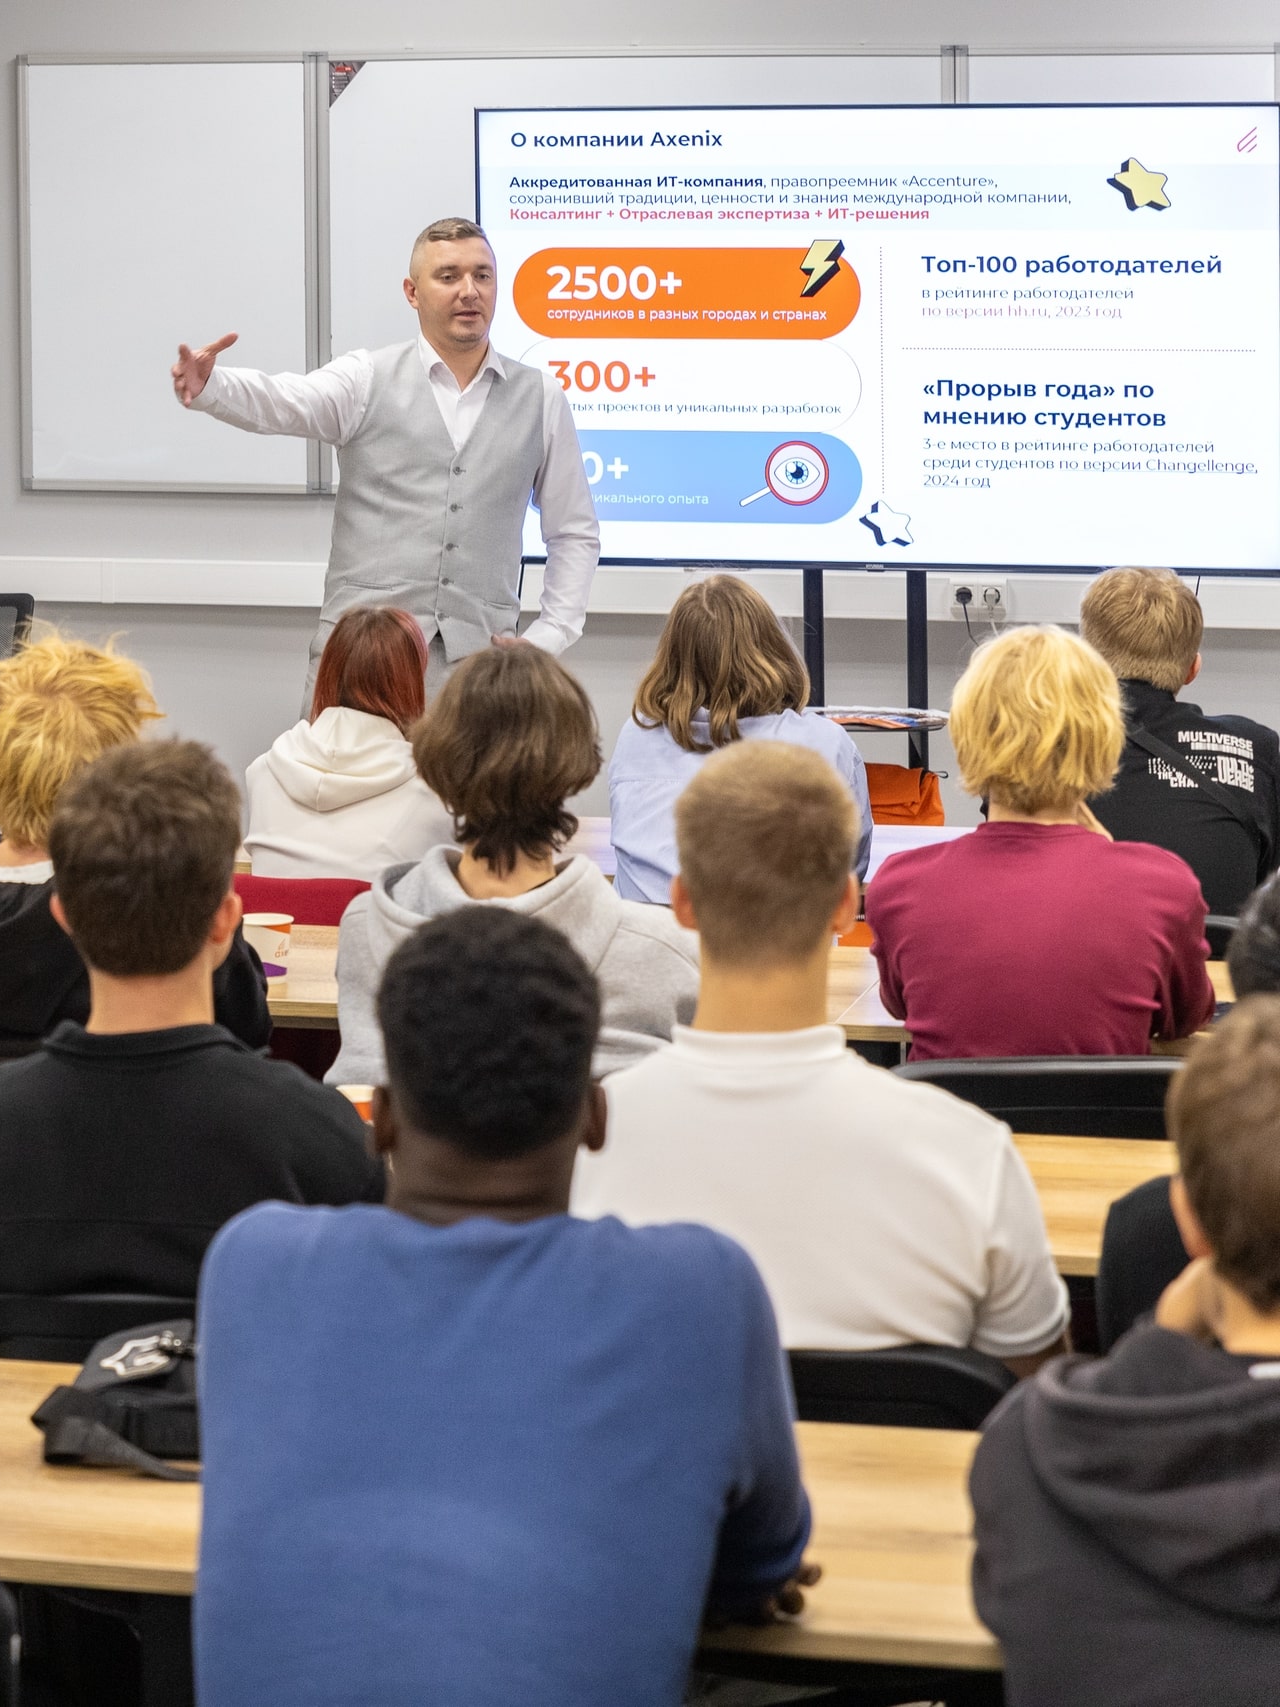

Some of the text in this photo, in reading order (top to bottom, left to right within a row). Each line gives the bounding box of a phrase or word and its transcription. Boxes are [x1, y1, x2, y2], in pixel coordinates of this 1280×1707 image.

[510, 129, 723, 148] О компании Axenix
[509, 175, 998, 190] Аккредитованная ИТ-компания, правопреемник «Accenture»,
[509, 190, 1072, 206] сохранивший традиции, ценности и знания международной компании,
[509, 208, 602, 221] Консалтинг
[619, 208, 713, 222] Отраслевая
[718, 209, 810, 222] экспертиза
[828, 208, 930, 222] ИТ-решения
[921, 254, 1222, 278] Топ-100 работодателей
[546, 265, 683, 301] 2500+
[922, 286, 1134, 301] в рейтинге работодателей
[547, 308, 827, 323] сотрудников в разных городах и странах
[922, 304, 1122, 319] по версии hh.ru, 2023 год
[548, 361, 656, 393] 300+
[923, 379, 1154, 401] «Прорыв года» по
[598, 403, 661, 414] проектов
[665, 403, 673, 412] и
[676, 403, 758, 414] уникальных
[762, 402, 842, 415] разработок
[923, 411, 1166, 430] мнению студентов
[923, 438, 1214, 454] 3-е место в рейтинге работодателей
[581, 450, 629, 485] 0+
[923, 459, 1258, 475] среди студентов по версии Changellenge,
[923, 474, 991, 488] 2024 год
[591, 494, 709, 505] икального опыта
[1178, 731, 1253, 751] MULTIVERSE
